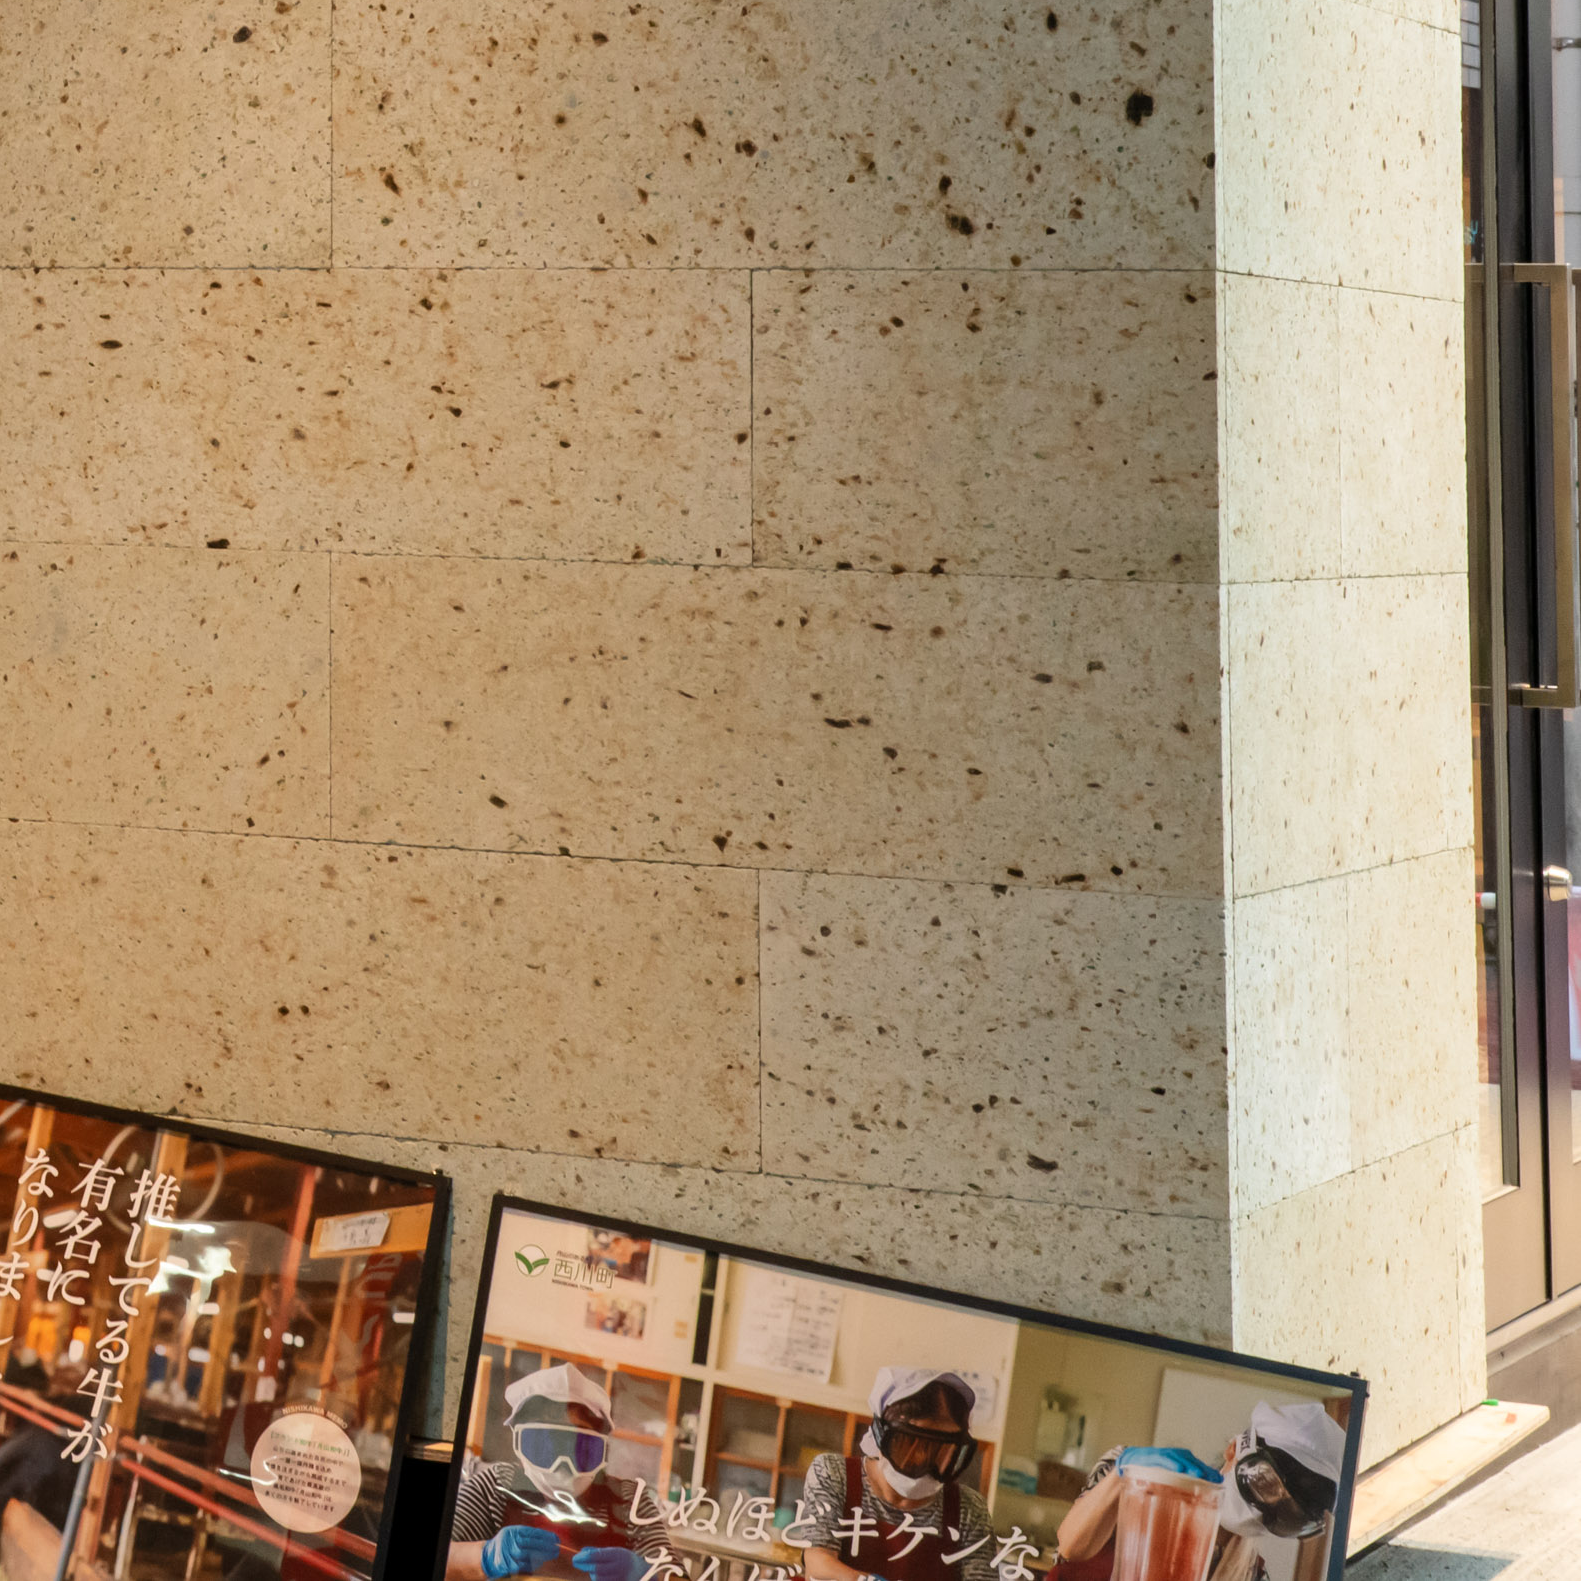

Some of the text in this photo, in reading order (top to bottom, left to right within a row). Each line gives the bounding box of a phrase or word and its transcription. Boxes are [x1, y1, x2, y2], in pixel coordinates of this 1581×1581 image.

[45, 1157, 125, 1307] 有名に
[553, 1258, 616, 1289] 西川町
[60, 1169, 182, 1464] 推してる牛が
[628, 1477, 1040, 1581] しぬほどキケンな
